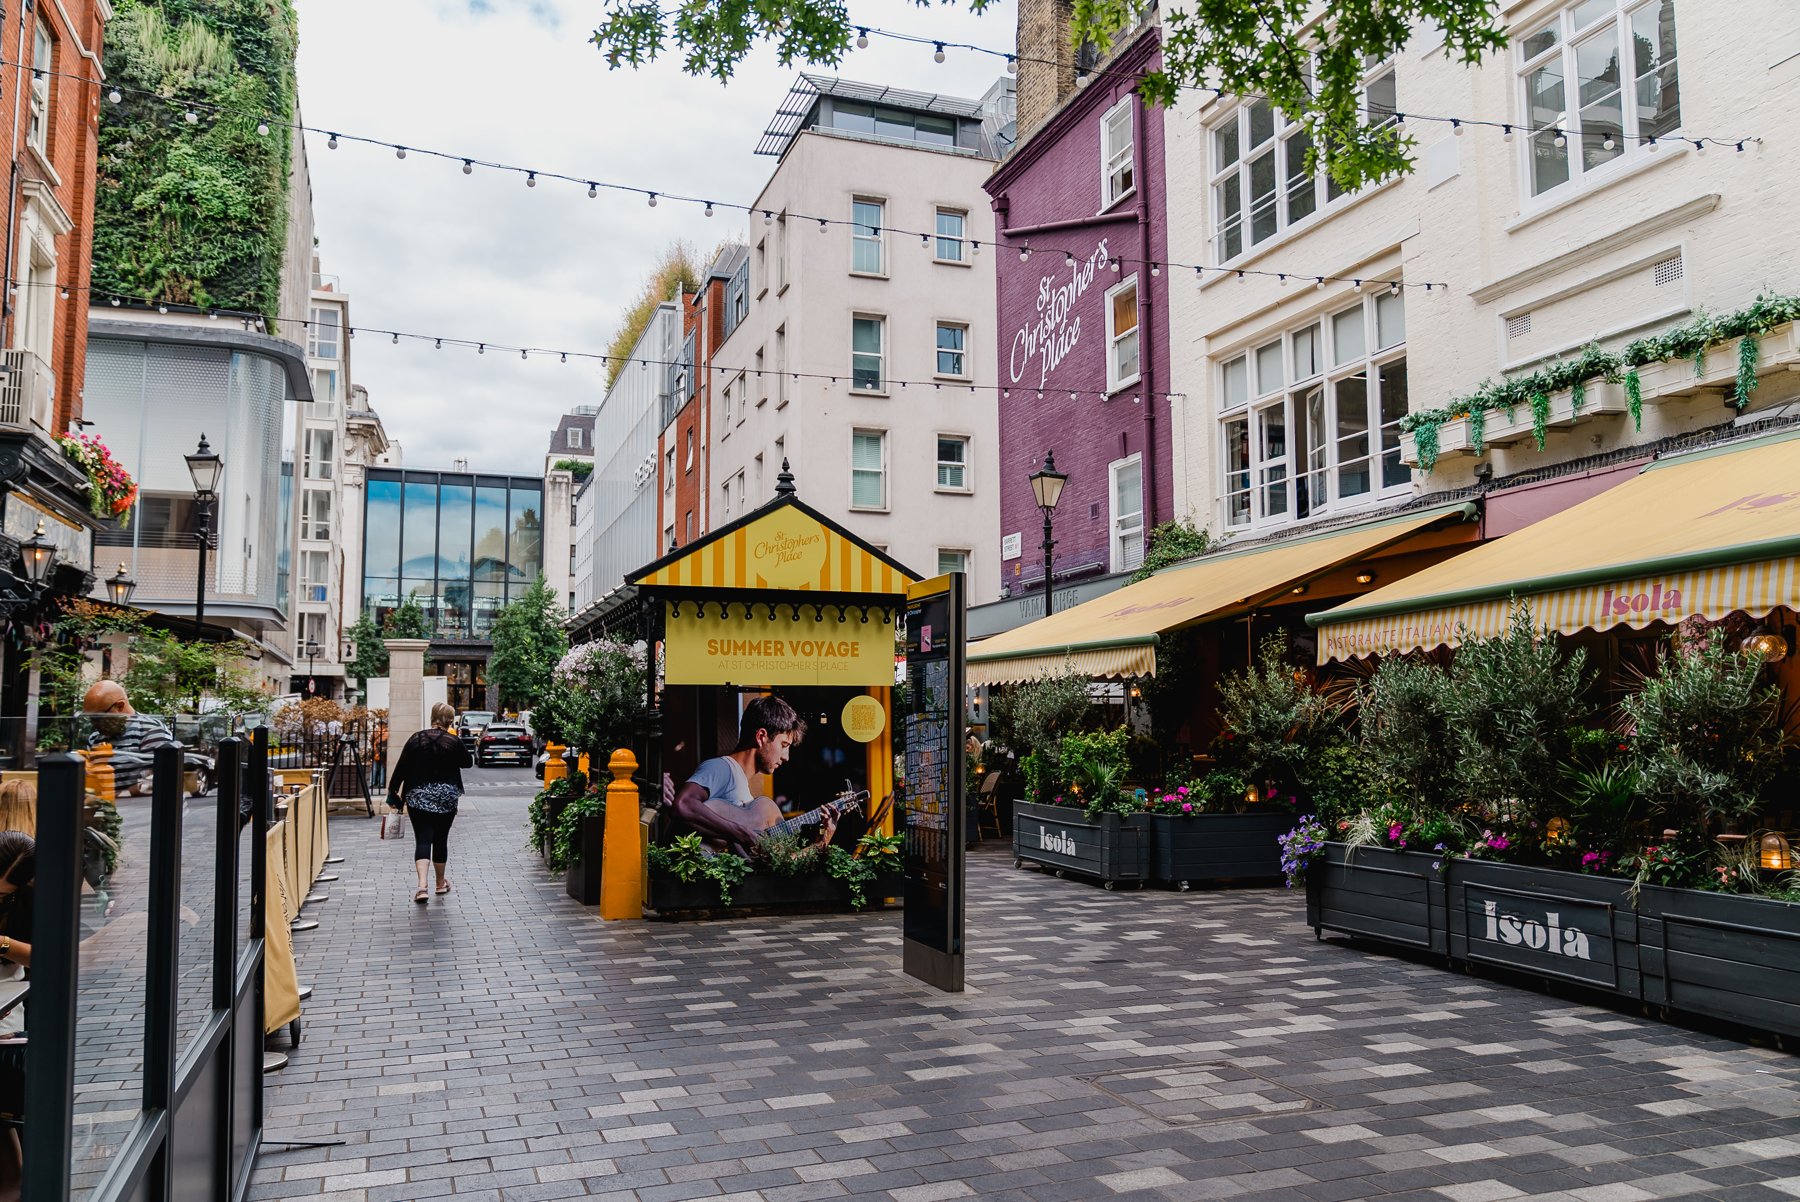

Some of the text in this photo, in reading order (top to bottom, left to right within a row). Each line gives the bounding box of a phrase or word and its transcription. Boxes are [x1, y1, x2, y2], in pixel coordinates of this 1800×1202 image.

[1036, 274, 1055, 311] St
[1040, 316, 1081, 391] Place
[774, 550, 803, 568] Place
[1601, 583, 1682, 617] Isola
[707, 638, 860, 658] SUMMER VOYAGE
[1327, 629, 1395, 650] RISTORANTE
[718, 660, 730, 670] AT
[731, 660, 743, 670] ST
[820, 661, 849, 671] PLACE
[1039, 825, 1076, 857] Isola
[1484, 899, 1592, 961] Isola
